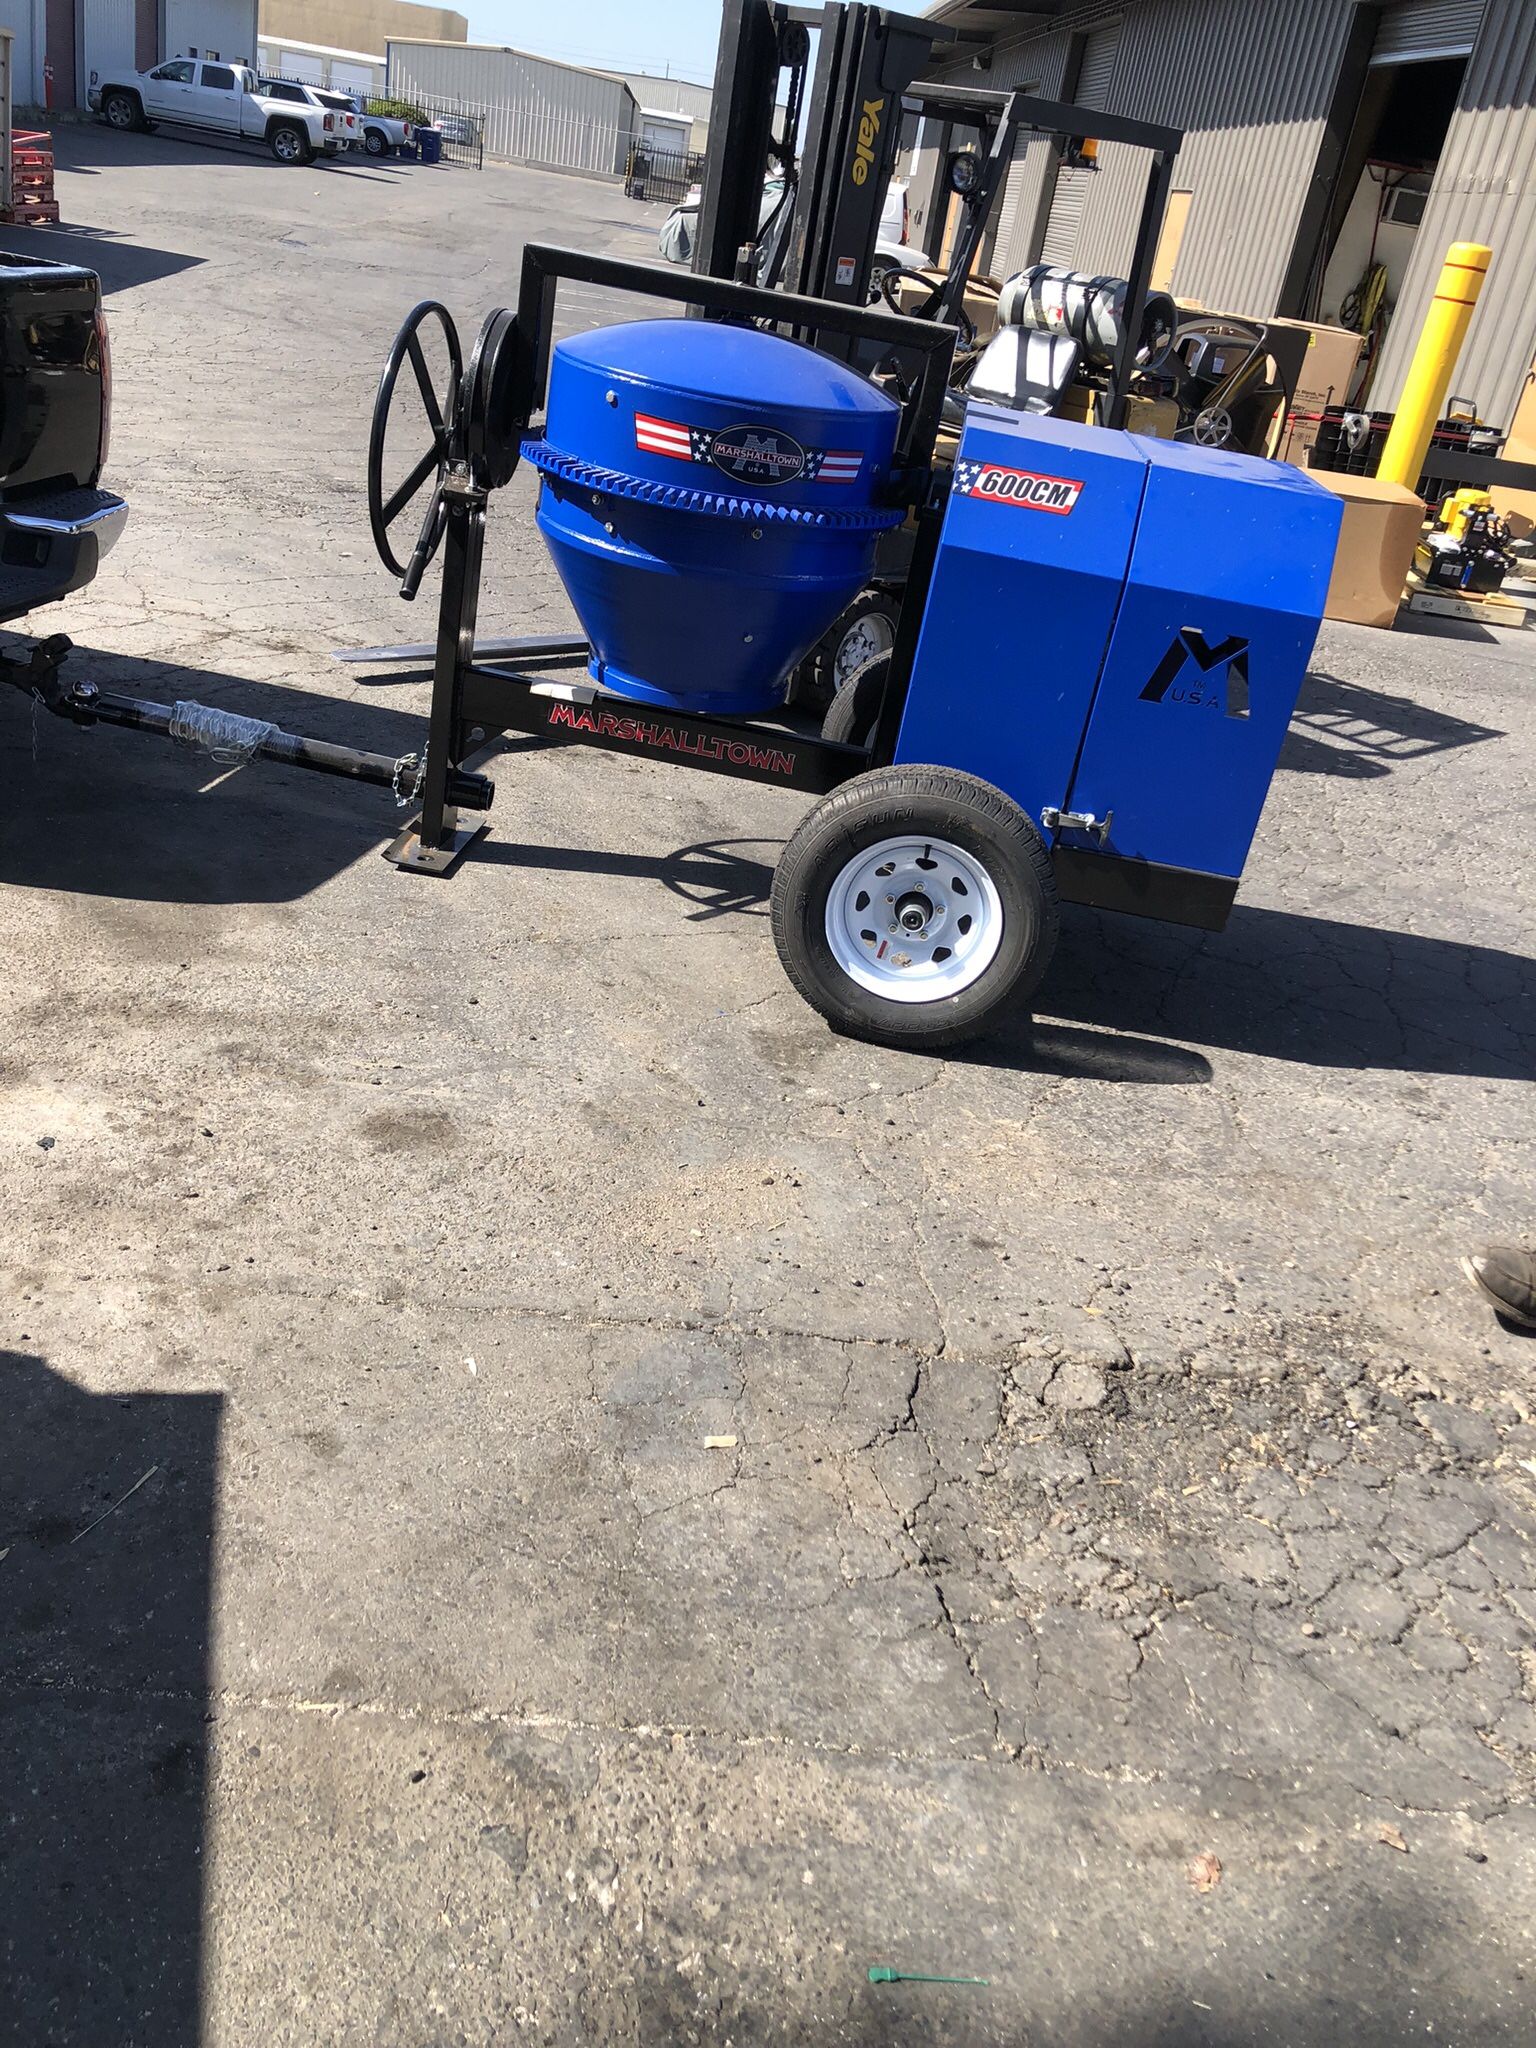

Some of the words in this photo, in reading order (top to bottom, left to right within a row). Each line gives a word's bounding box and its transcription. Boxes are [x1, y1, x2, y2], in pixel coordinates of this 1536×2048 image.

[852, 98, 884, 186] Yale
[715, 444, 800, 467] MARSHALLTOWN
[747, 466, 765, 475] USA
[981, 471, 1074, 507] 600CM
[548, 702, 797, 776] MARSHALLTOWN
